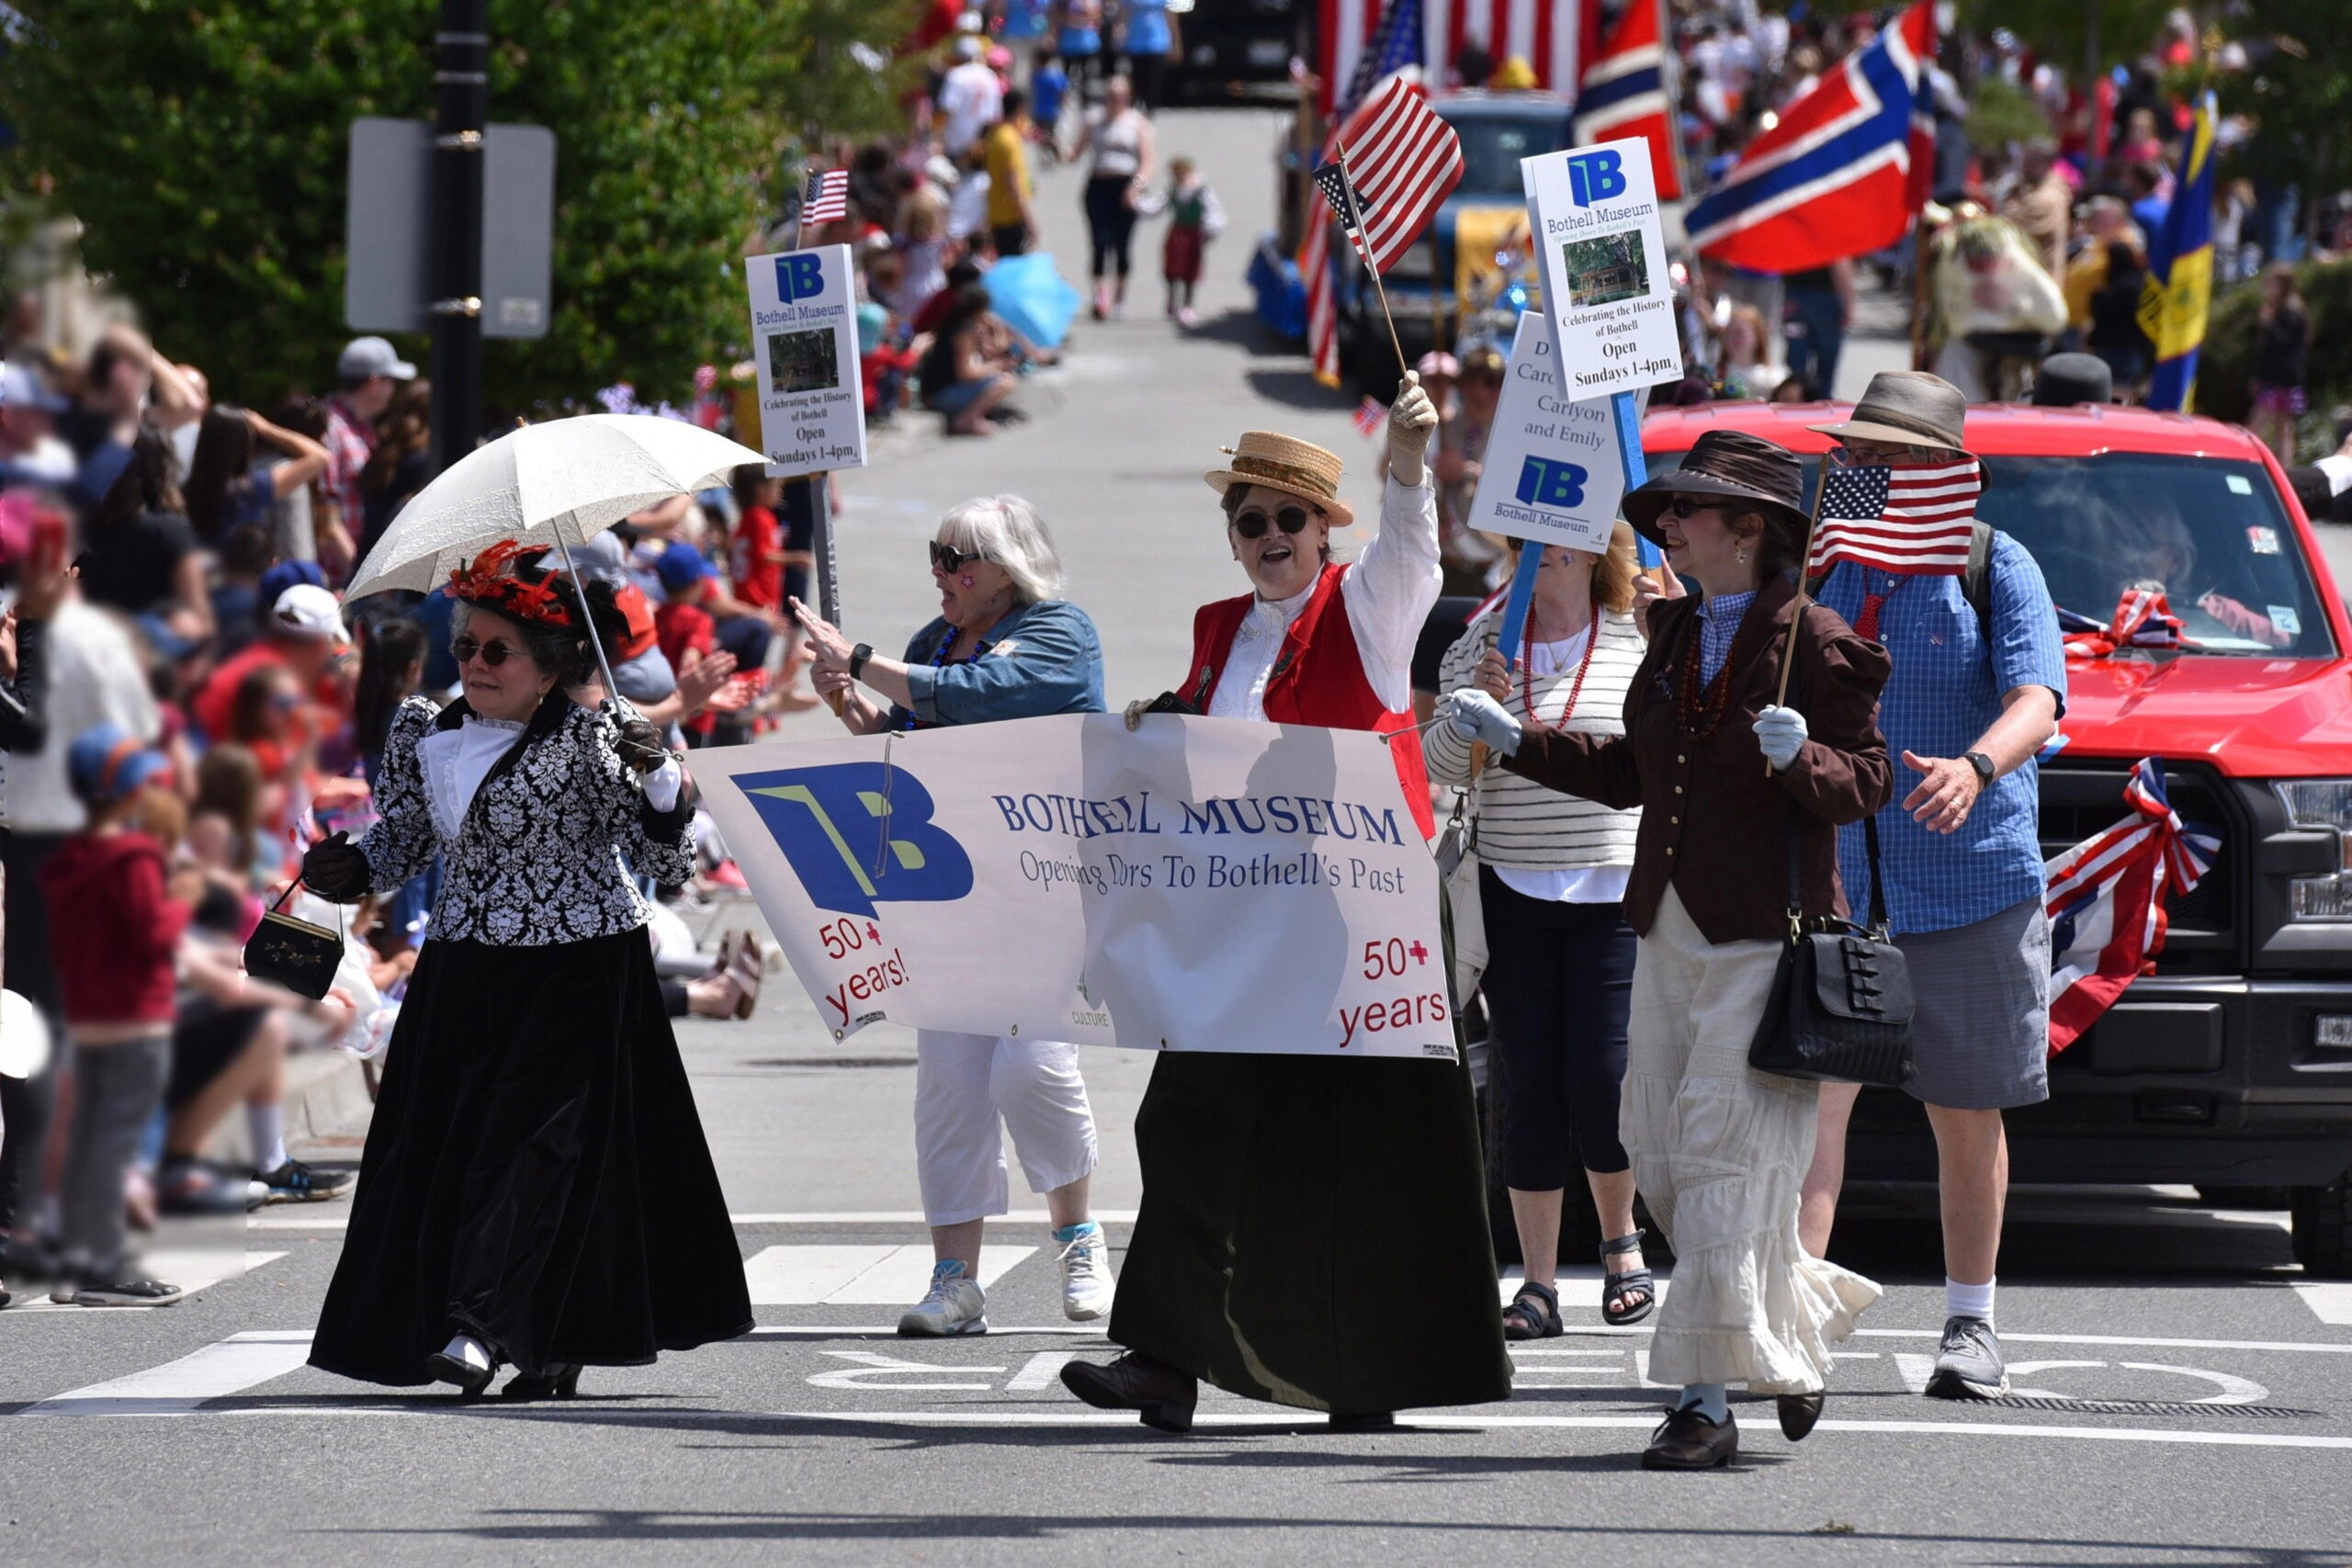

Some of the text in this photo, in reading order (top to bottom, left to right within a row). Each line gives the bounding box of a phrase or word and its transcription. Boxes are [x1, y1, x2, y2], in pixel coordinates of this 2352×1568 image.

[1547, 203, 1653, 233] Bothell Museum
[756, 304, 845, 325] Bothell Museum
[1562, 299, 1667, 327] Celebrating the History
[1595, 320, 1638, 338] of Bothell
[1602, 341, 1637, 359] Open
[1575, 366, 1629, 387] Sundays
[1633, 357, 1672, 376] 1-4pm
[763, 391, 851, 410] Celebrating the History
[1538, 395, 1606, 423] Carlyon
[791, 408, 827, 423] of Bothell
[796, 426, 826, 444] Open
[1524, 422, 1606, 452] and Emily
[772, 445, 854, 465] Sundays 1-4pm
[1495, 505, 1589, 534] Bothell Museum
[991, 791, 1406, 846] BOTHELL MUSEUM
[1020, 851, 1108, 896] Opening
[1162, 855, 1195, 888] To
[1207, 852, 1340, 888] Bothell's
[1348, 858, 1406, 895] Past
[820, 918, 882, 960] 50+
[1363, 937, 1429, 980] 50+
[825, 947, 910, 1028] years!
[1071, 1010, 1109, 1027] CULTURE
[1339, 993, 1445, 1048] years
